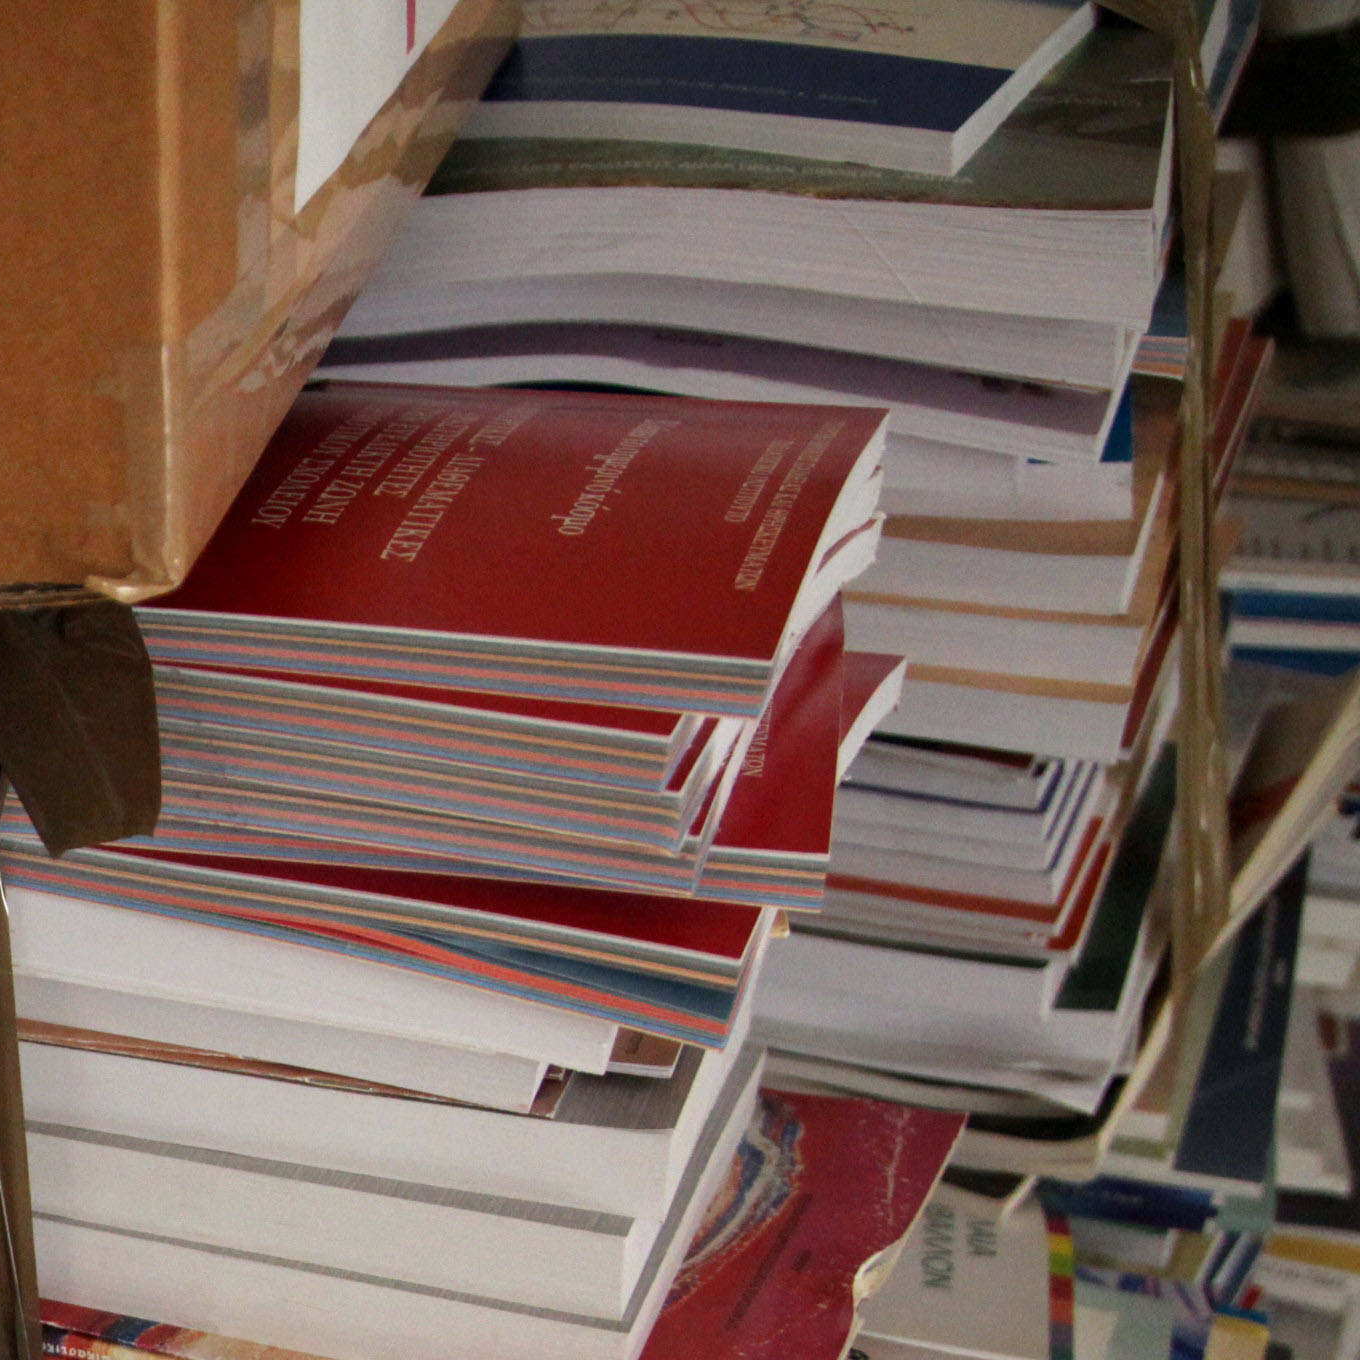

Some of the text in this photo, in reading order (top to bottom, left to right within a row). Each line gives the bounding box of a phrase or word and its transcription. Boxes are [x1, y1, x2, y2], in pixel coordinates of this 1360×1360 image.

[246, 457, 340, 528] ΣΧΟΛΕΙΟΥ
[300, 479, 366, 524] ΖΩΝΗ
[554, 494, 611, 538] κόσμο
